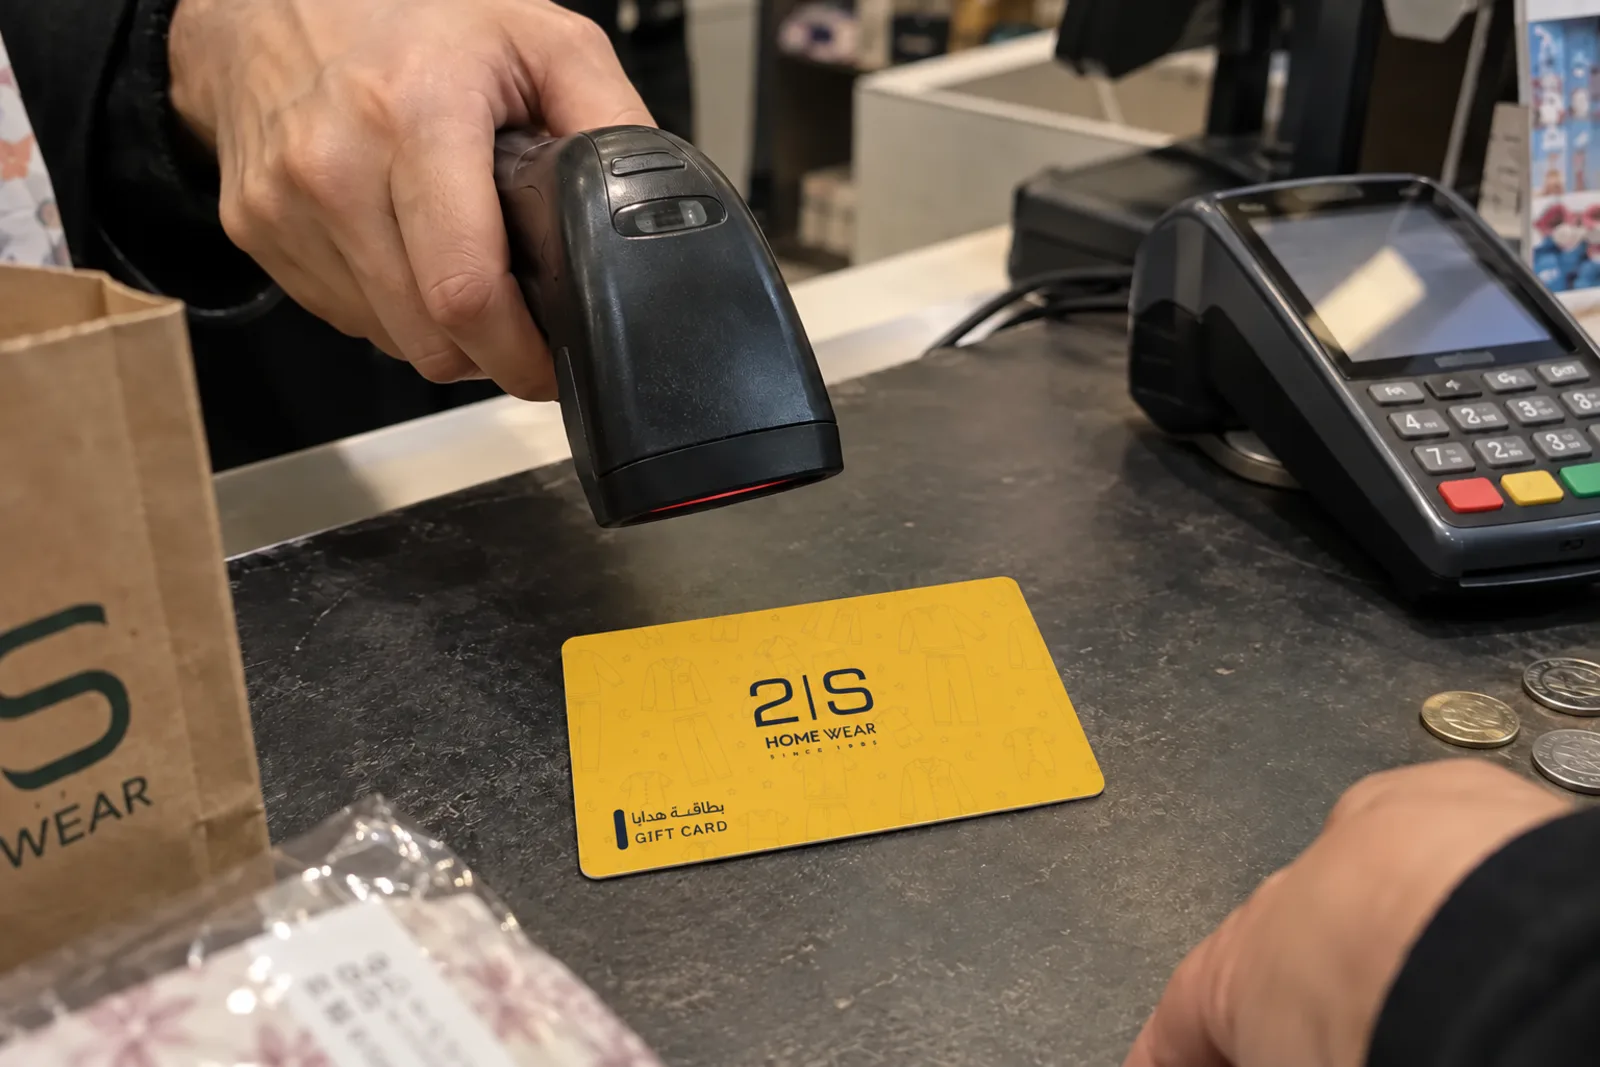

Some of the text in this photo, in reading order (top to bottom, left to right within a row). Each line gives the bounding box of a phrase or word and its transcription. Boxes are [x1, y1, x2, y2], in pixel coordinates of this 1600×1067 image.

[1405, 413, 1421, 430] 4
[1460, 407, 1481, 425] 2
[1425, 447, 1443, 466] 7
[1487, 441, 1509, 458] 2
[765, 722, 877, 749] HOME WEAR
[0, 776, 154, 869] WEAR
[631, 810, 668, 827] هدايا
[634, 820, 728, 844] GIFT CARD
